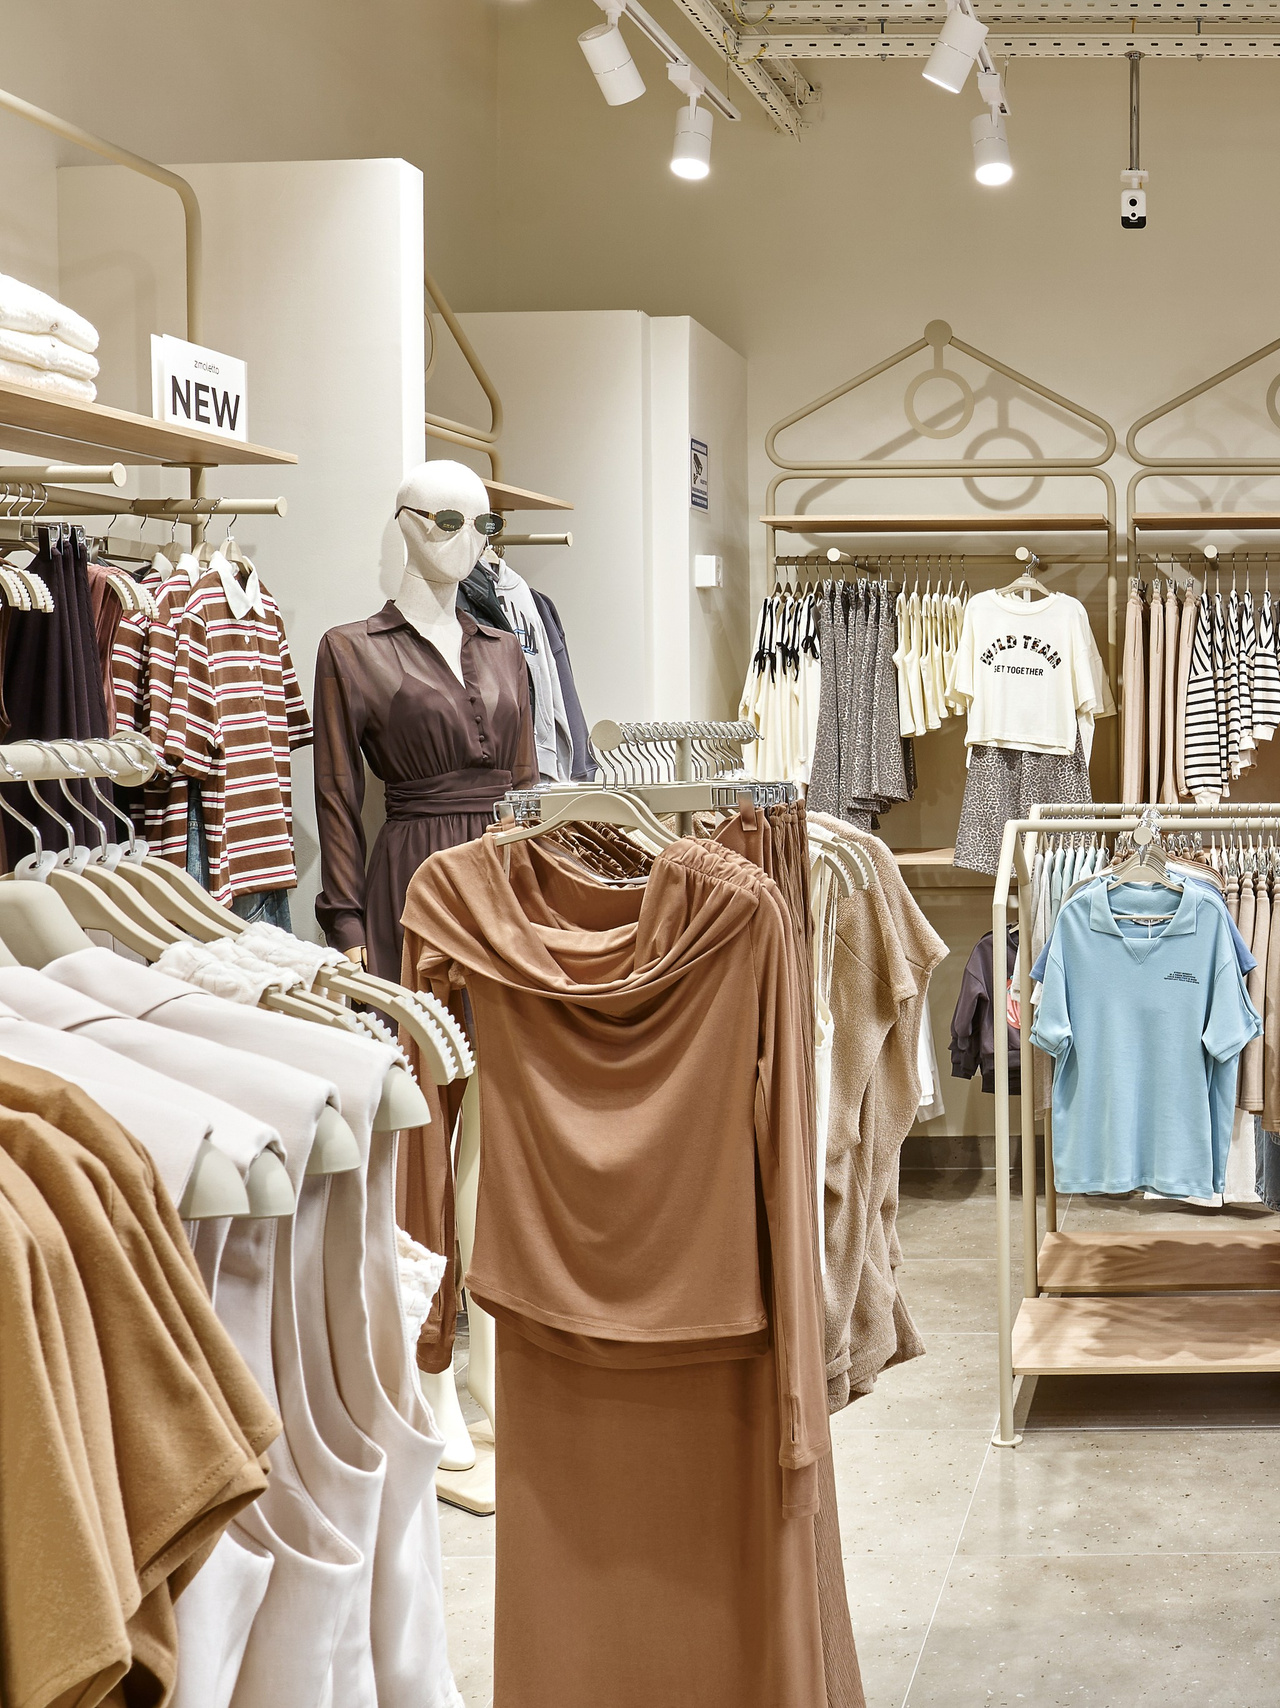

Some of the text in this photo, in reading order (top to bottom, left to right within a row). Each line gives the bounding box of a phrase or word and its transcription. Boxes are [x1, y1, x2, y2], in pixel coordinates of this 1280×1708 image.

[171, 375, 240, 431] NEW
[980, 635, 1062, 669] WILD TEAM
[1007, 666, 1044, 676] TOGETHER
